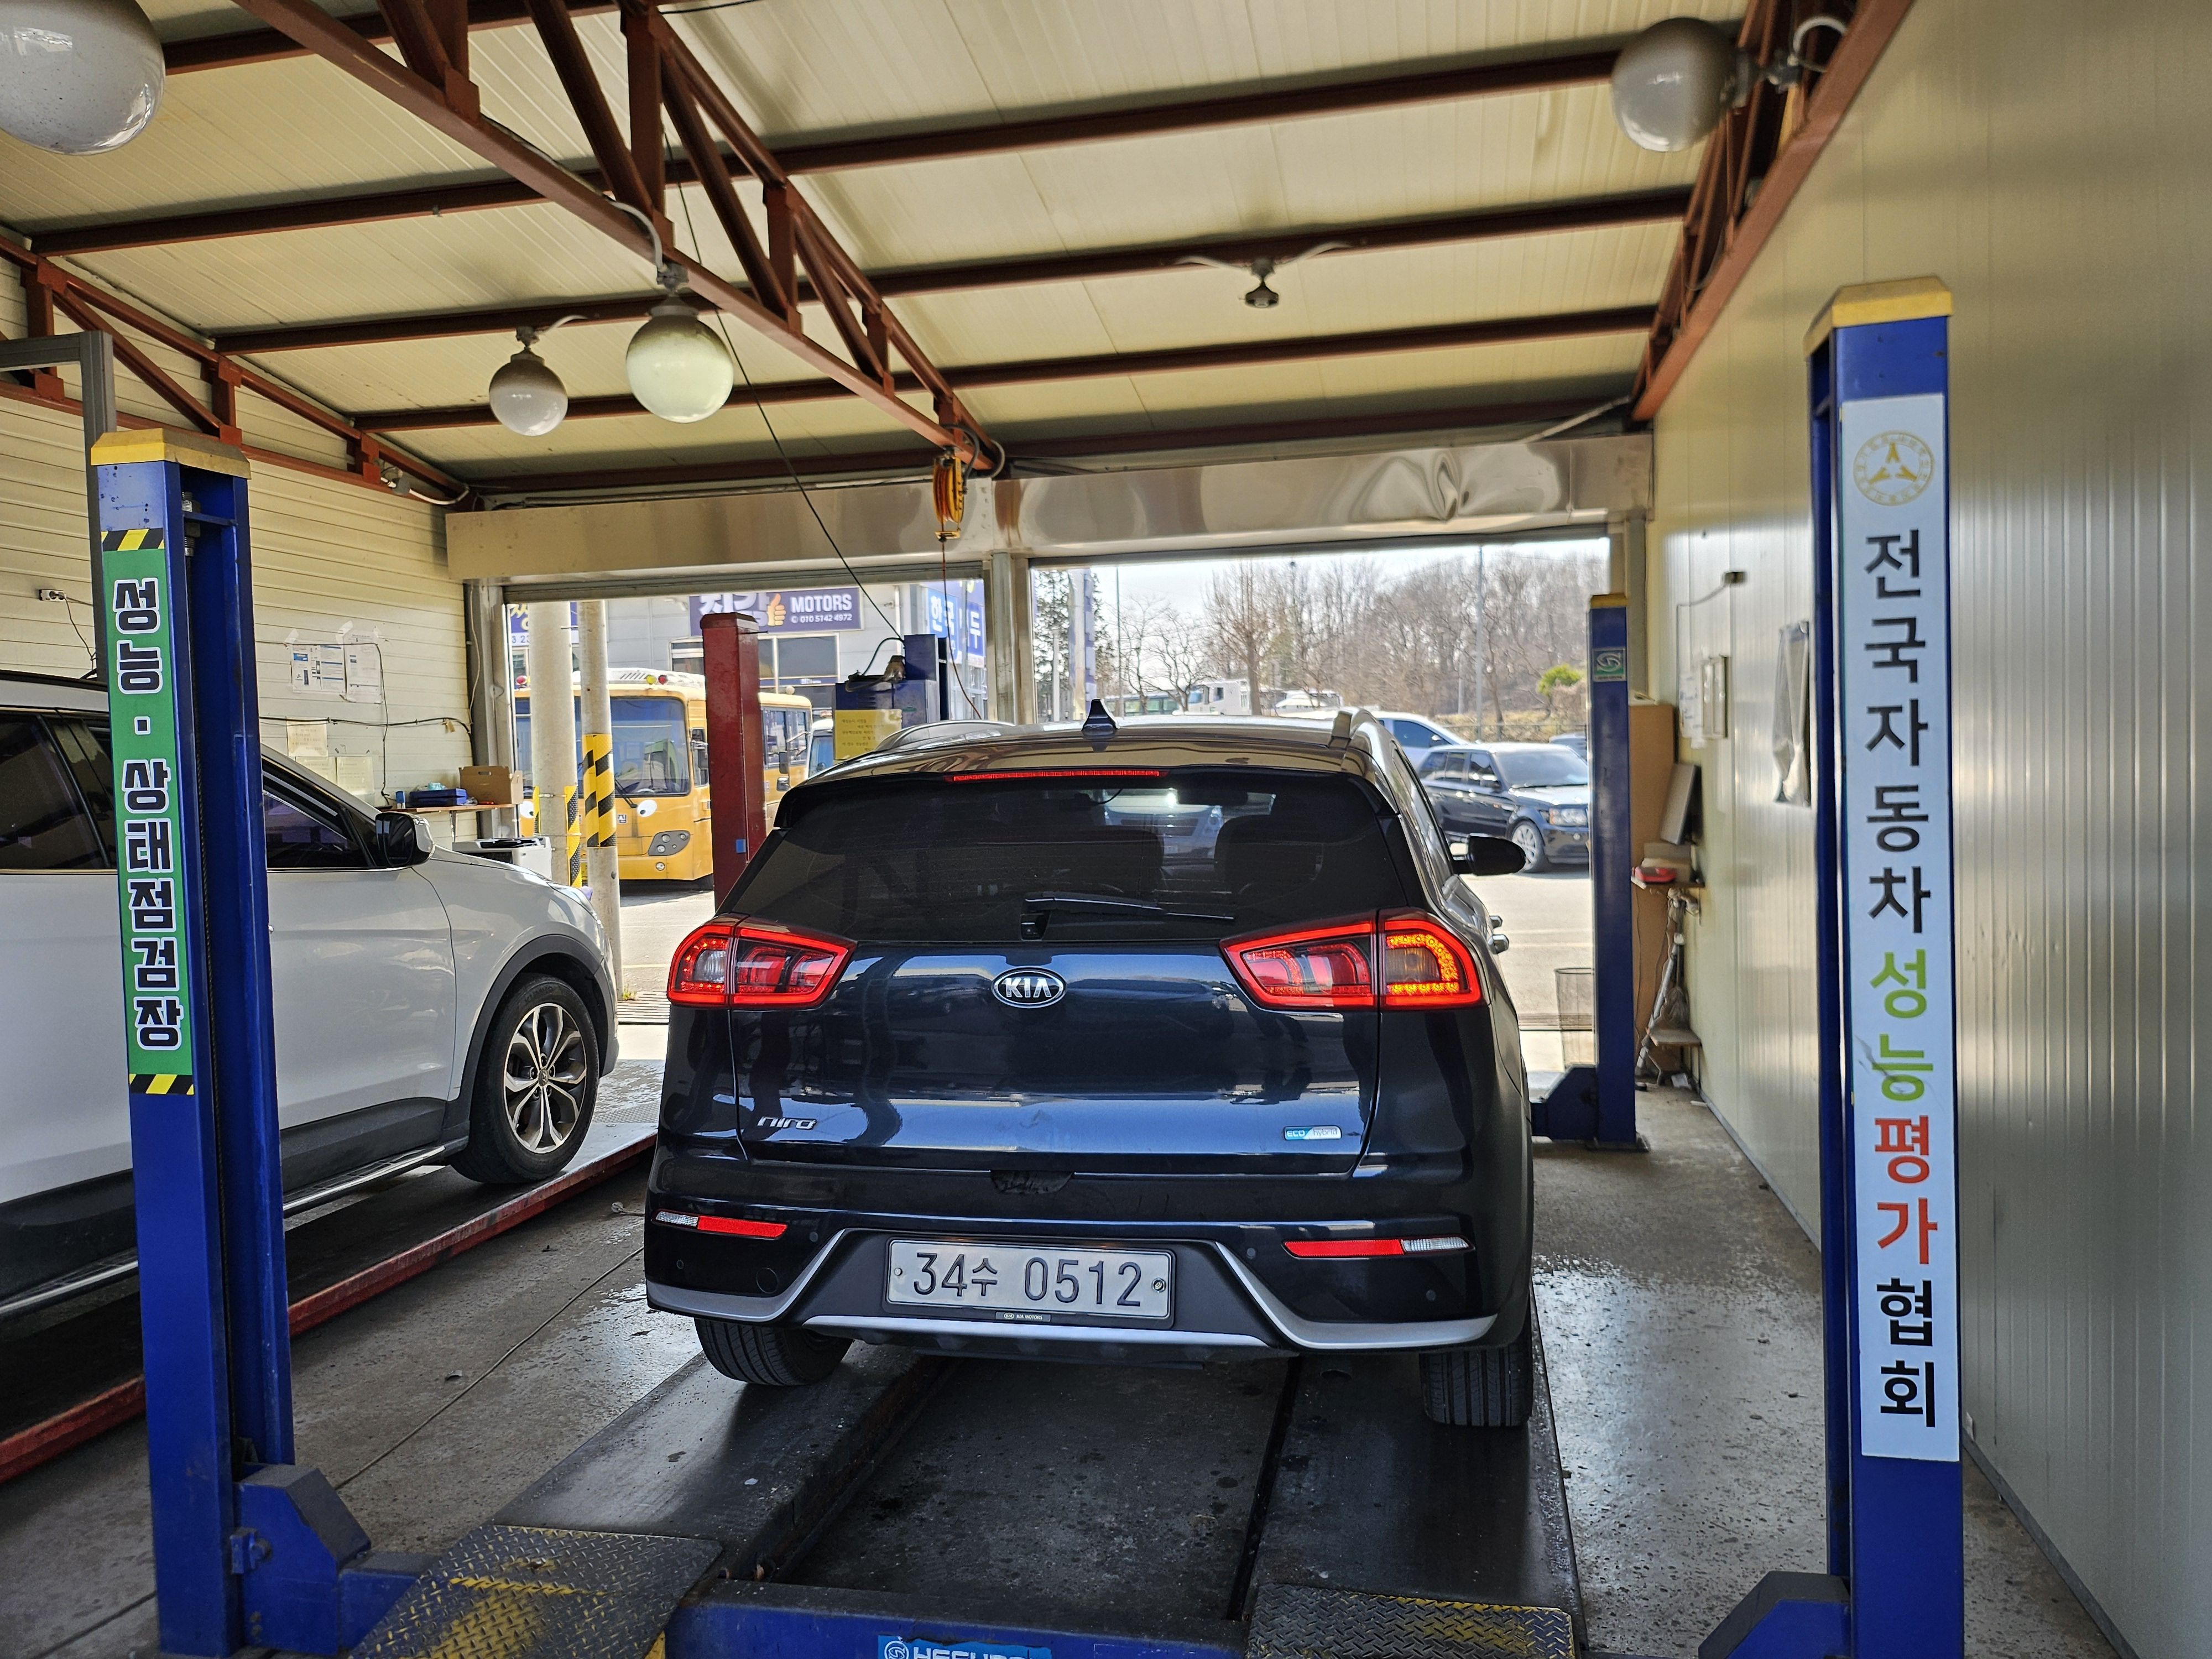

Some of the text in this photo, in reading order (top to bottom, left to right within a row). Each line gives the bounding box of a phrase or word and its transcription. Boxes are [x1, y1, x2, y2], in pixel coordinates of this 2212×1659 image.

[790, 593, 852, 613] MOTORS
[800, 613, 853, 623] 010 5142 4972
[1005, 977, 1052, 998] KIA
[1313, 1128, 1337, 1136] hybrid
[914, 1252, 1141, 1307] 34수 0512
